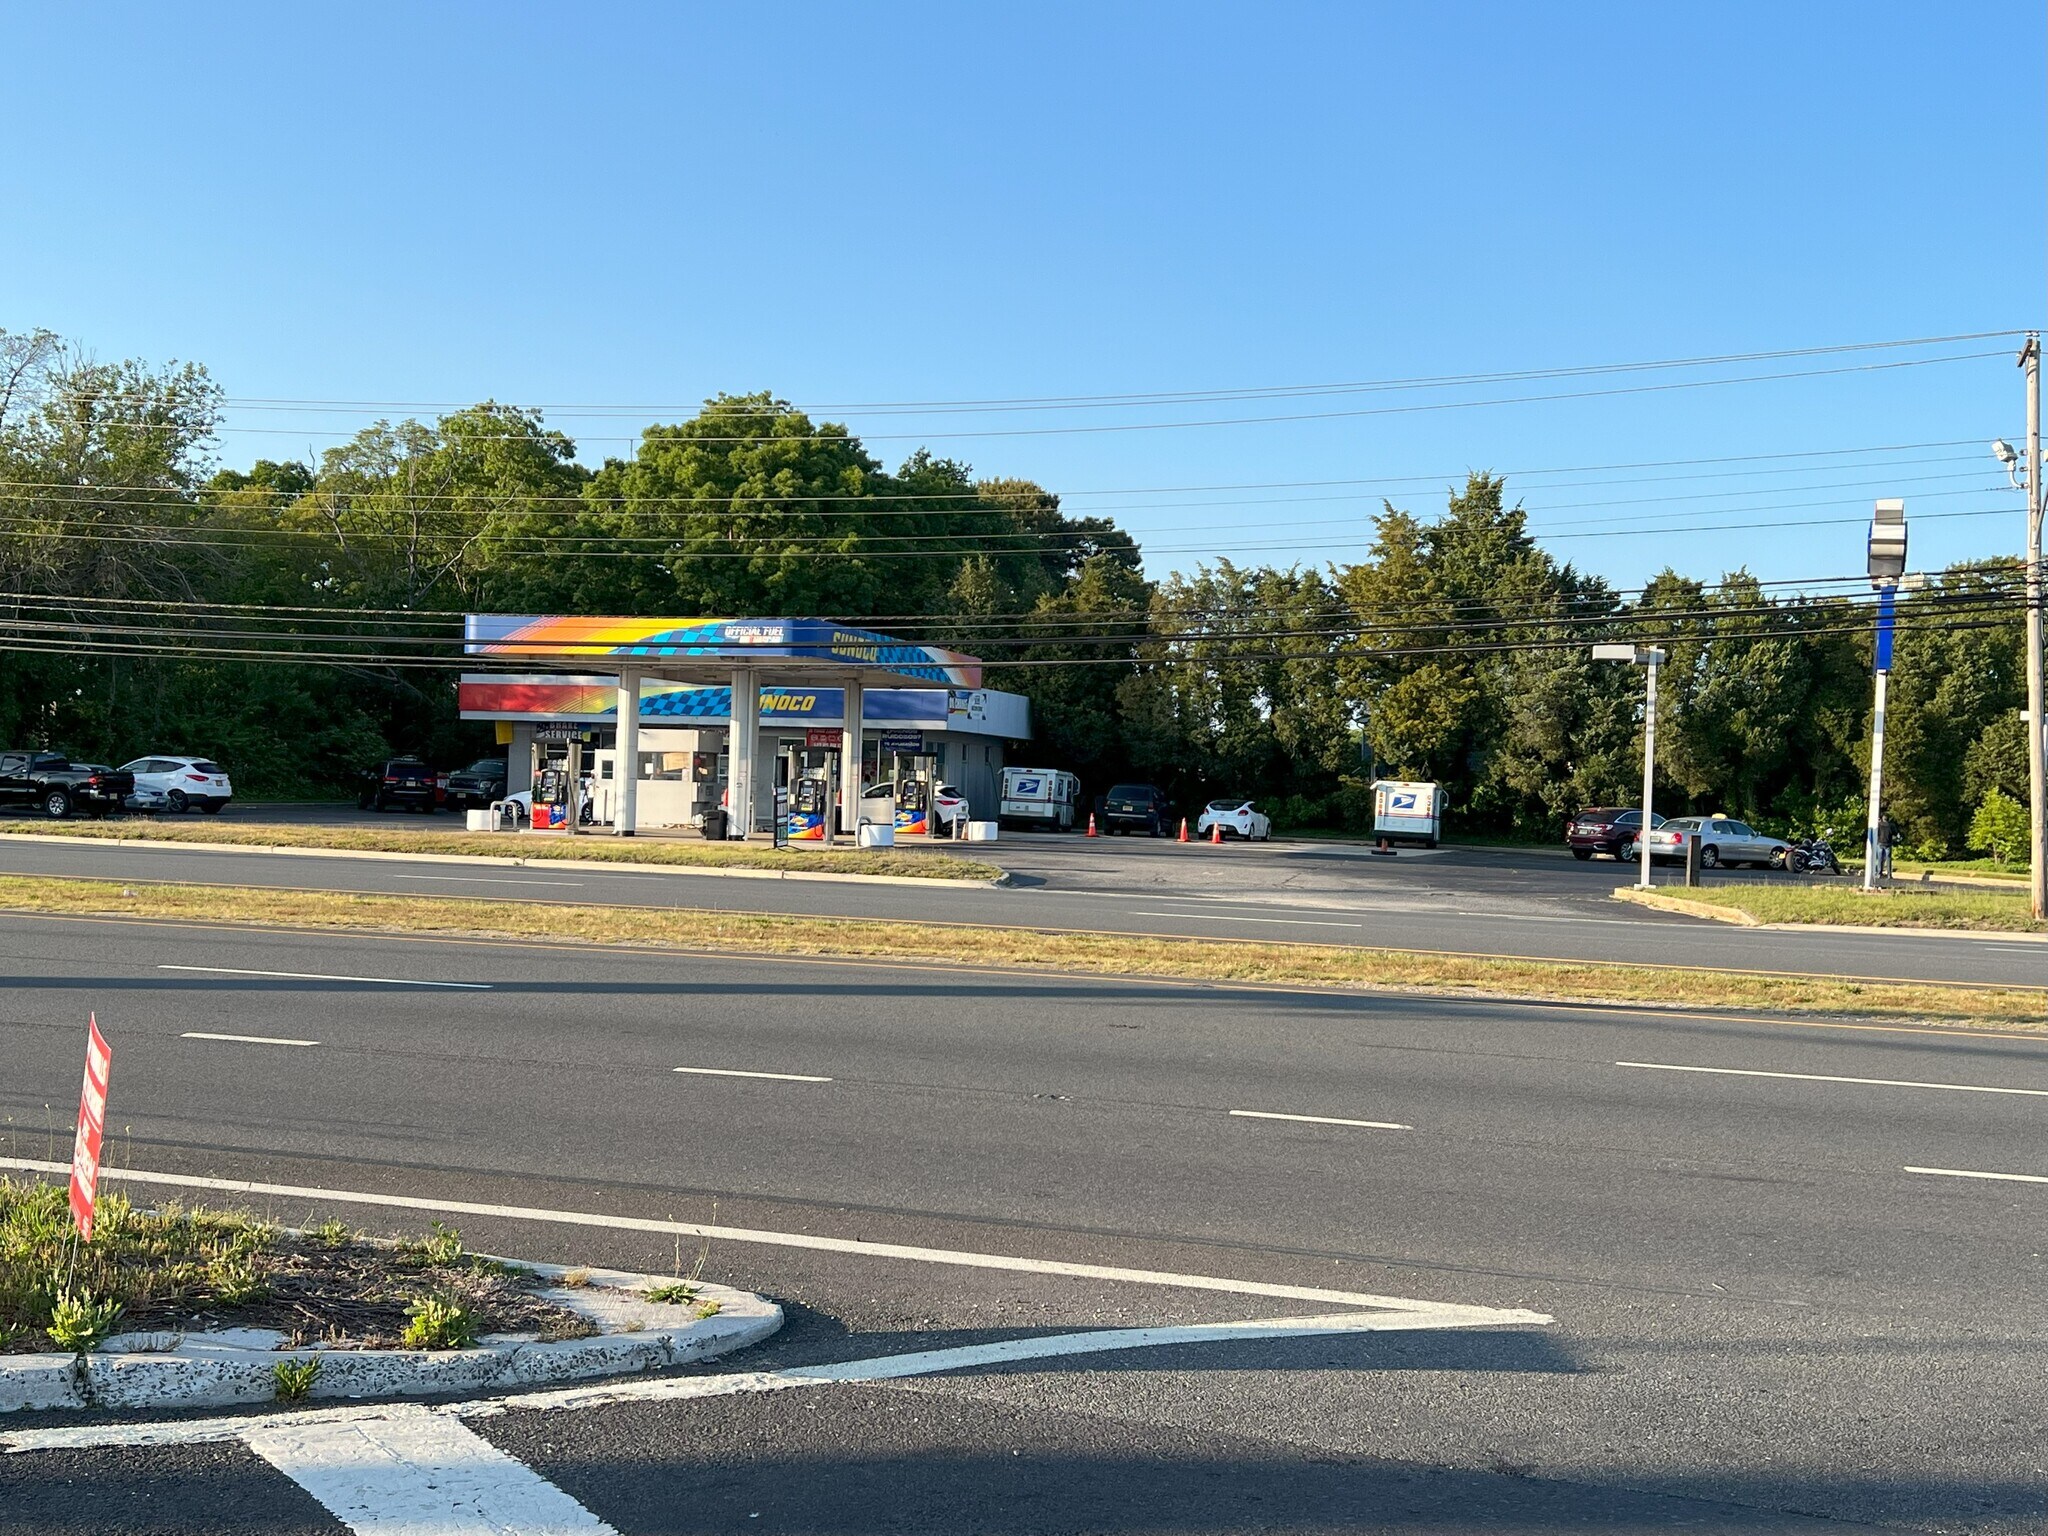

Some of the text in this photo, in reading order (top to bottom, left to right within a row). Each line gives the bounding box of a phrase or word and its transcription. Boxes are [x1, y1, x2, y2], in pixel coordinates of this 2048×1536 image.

[724, 626, 784, 637] OFFICIAL FUEL
[831, 631, 878, 662] SUNOCO
[759, 694, 816, 711] NOCO
[545, 730, 583, 739] SERVICE
